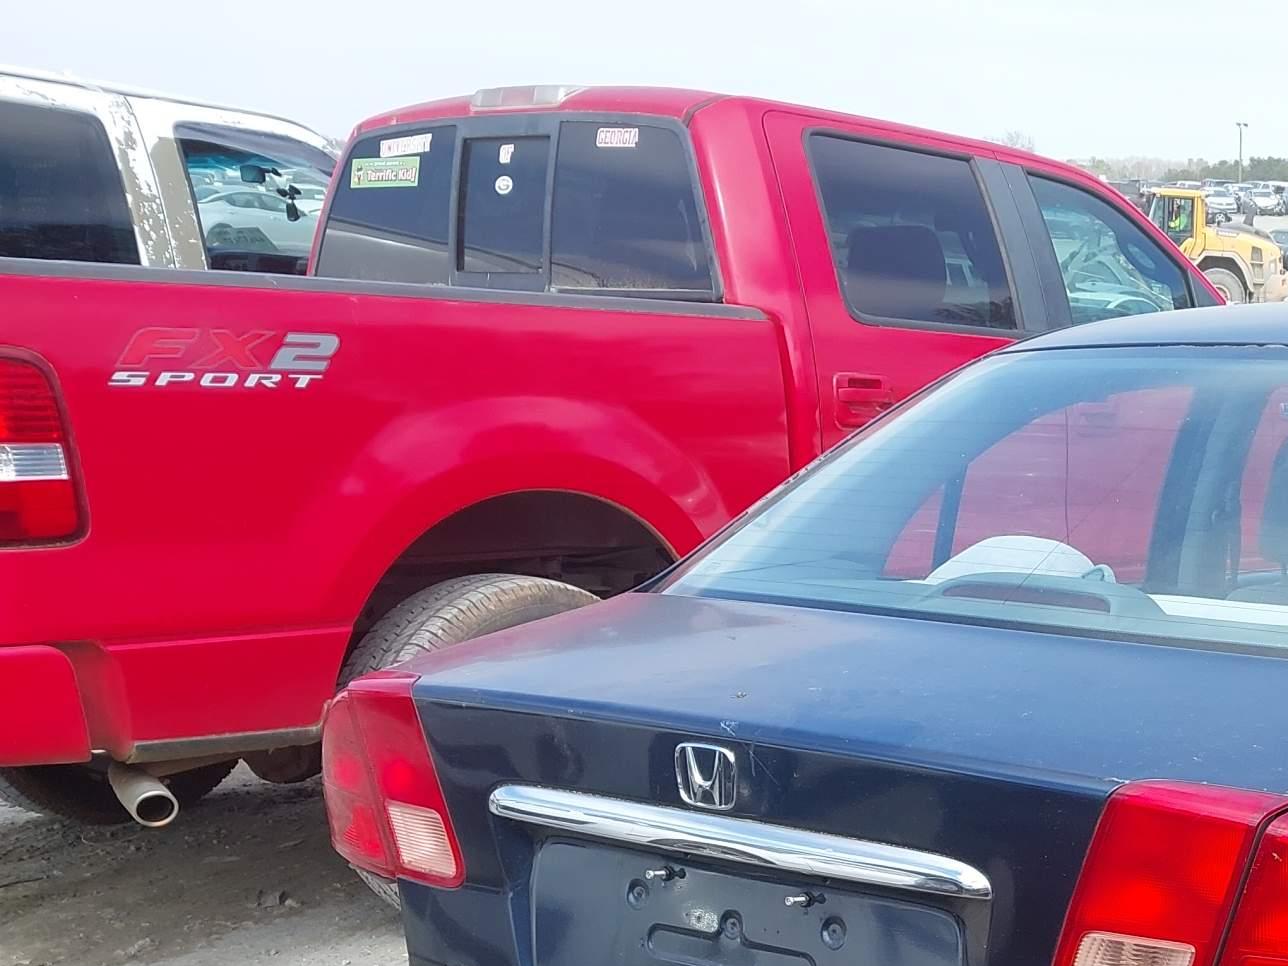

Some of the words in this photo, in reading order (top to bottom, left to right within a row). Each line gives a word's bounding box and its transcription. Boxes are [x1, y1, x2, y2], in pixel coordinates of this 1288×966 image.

[597, 129, 638, 146] GEORGIA
[367, 169, 397, 181] Terrific
[115, 327, 340, 371] FX2
[108, 371, 323, 388] SPORT
